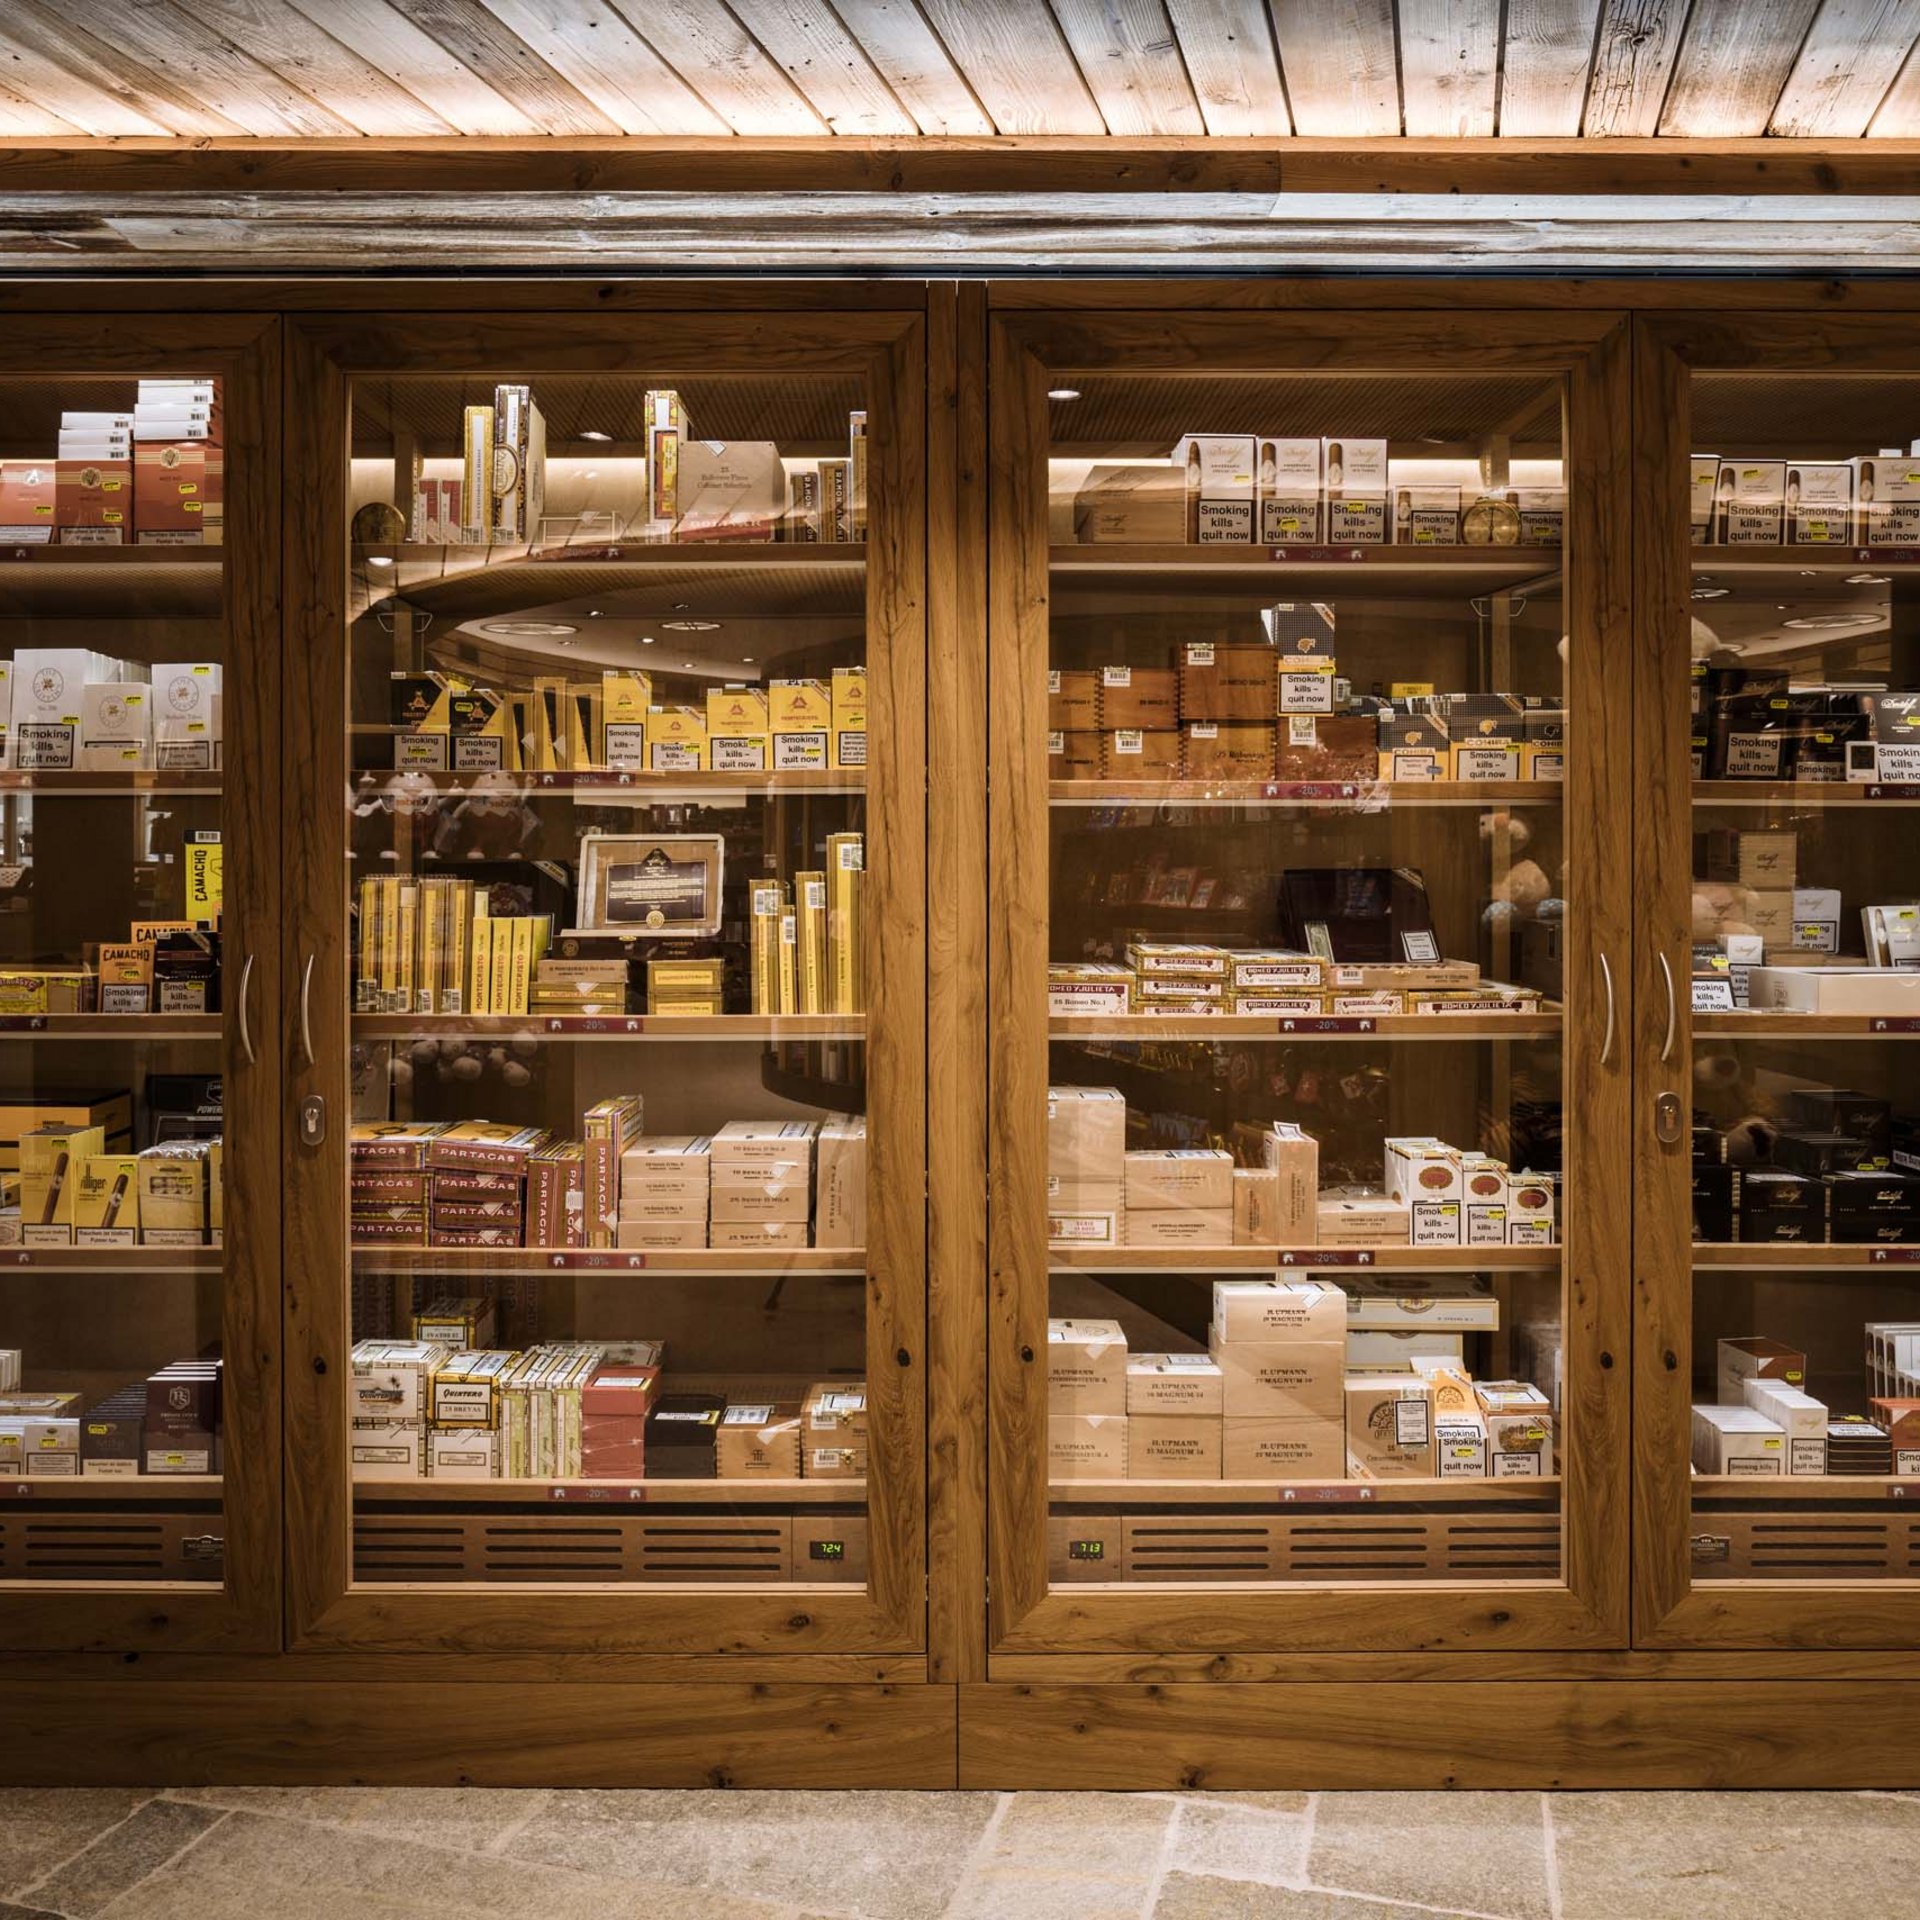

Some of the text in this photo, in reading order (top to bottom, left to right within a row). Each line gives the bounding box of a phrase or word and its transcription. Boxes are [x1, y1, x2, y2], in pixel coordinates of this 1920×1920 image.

[1201, 505, 1249, 518] Smoking
[1266, 504, 1315, 517] Smoking
[1730, 506, 1779, 518] Smoking
[1798, 507, 1844, 518] Smoking
[1211, 517, 1234, 528] kills
[1344, 517, 1366, 528] kills
[1414, 515, 1456, 525] Smoking
[1740, 519, 1762, 528] kills
[1880, 519, 1906, 528] kills
[1202, 530, 1249, 542] quit now
[1266, 530, 1315, 542] quit now
[1333, 530, 1382, 542] quit now
[1730, 532, 1752, 542] quit
[1871, 531, 1918, 542] quit now
[1287, 675, 1326, 685] Smoking
[1287, 694, 1303, 704] quit
[22, 729, 70, 741] Smoking
[609, 730, 640, 738] Smoking
[401, 736, 439, 746] Smoking
[459, 740, 498, 749] Smoking
[719, 740, 748, 750] Smoki
[781, 735, 819, 745] Smoking
[1465, 738, 1512, 746] COHIBA
[1730, 738, 1778, 748] Smoking
[466, 749, 484, 757] kills
[660, 744, 684, 752] Smoki
[788, 745, 805, 753] kills
[1879, 748, 1920, 758] Smokin
[609, 752, 622, 761] quit
[726, 750, 743, 758] kills
[782, 754, 799, 764] quit
[1470, 752, 1507, 761] Smoking
[1739, 750, 1762, 759] kills
[401, 756, 417, 766] quit
[459, 760, 476, 768] quit
[720, 760, 736, 769] quit
[1890, 760, 1914, 768] kills
[1729, 764, 1776, 773] quit now
[1798, 765, 1837, 776] Smoking
[1470, 770, 1486, 778] quit
[1884, 772, 1905, 782] quit
[194, 850, 208, 902] CAMACHO
[103, 949, 150, 960] CAMACHO
[1692, 984, 1724, 993] moking
[171, 992, 188, 1000] kills
[112, 998, 132, 1006] kills
[582, 1021, 606, 1029] -20%
[440, 1148, 516, 1163] PARTAGAS
[540, 1172, 548, 1248] PARTAGAS
[1424, 1219, 1442, 1228] kills
[1418, 1231, 1434, 1241] quit
[1437, 1430, 1476, 1439] Smoking
[1443, 1438, 1482, 1446] Smoking
[1794, 1445, 1824, 1453] Smoking
[1444, 1462, 1462, 1471] quit
[1794, 1462, 1806, 1470] quit
